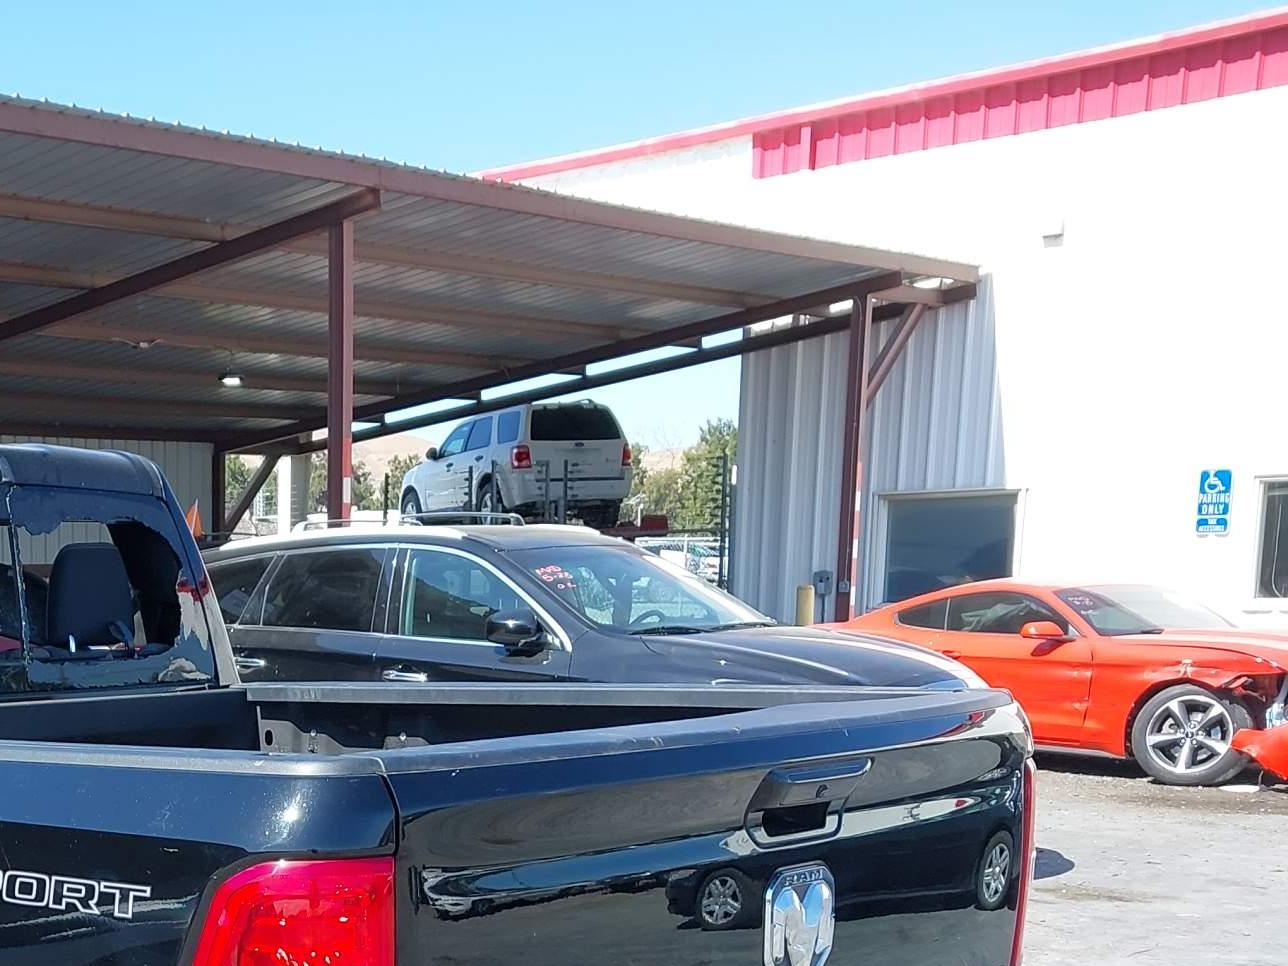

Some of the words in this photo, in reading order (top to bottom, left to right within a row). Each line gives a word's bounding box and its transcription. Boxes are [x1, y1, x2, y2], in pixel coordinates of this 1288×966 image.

[1198, 493, 1230, 504] PARKING
[1201, 503, 1225, 515] ONLY
[783, 868, 824, 887] RAM
